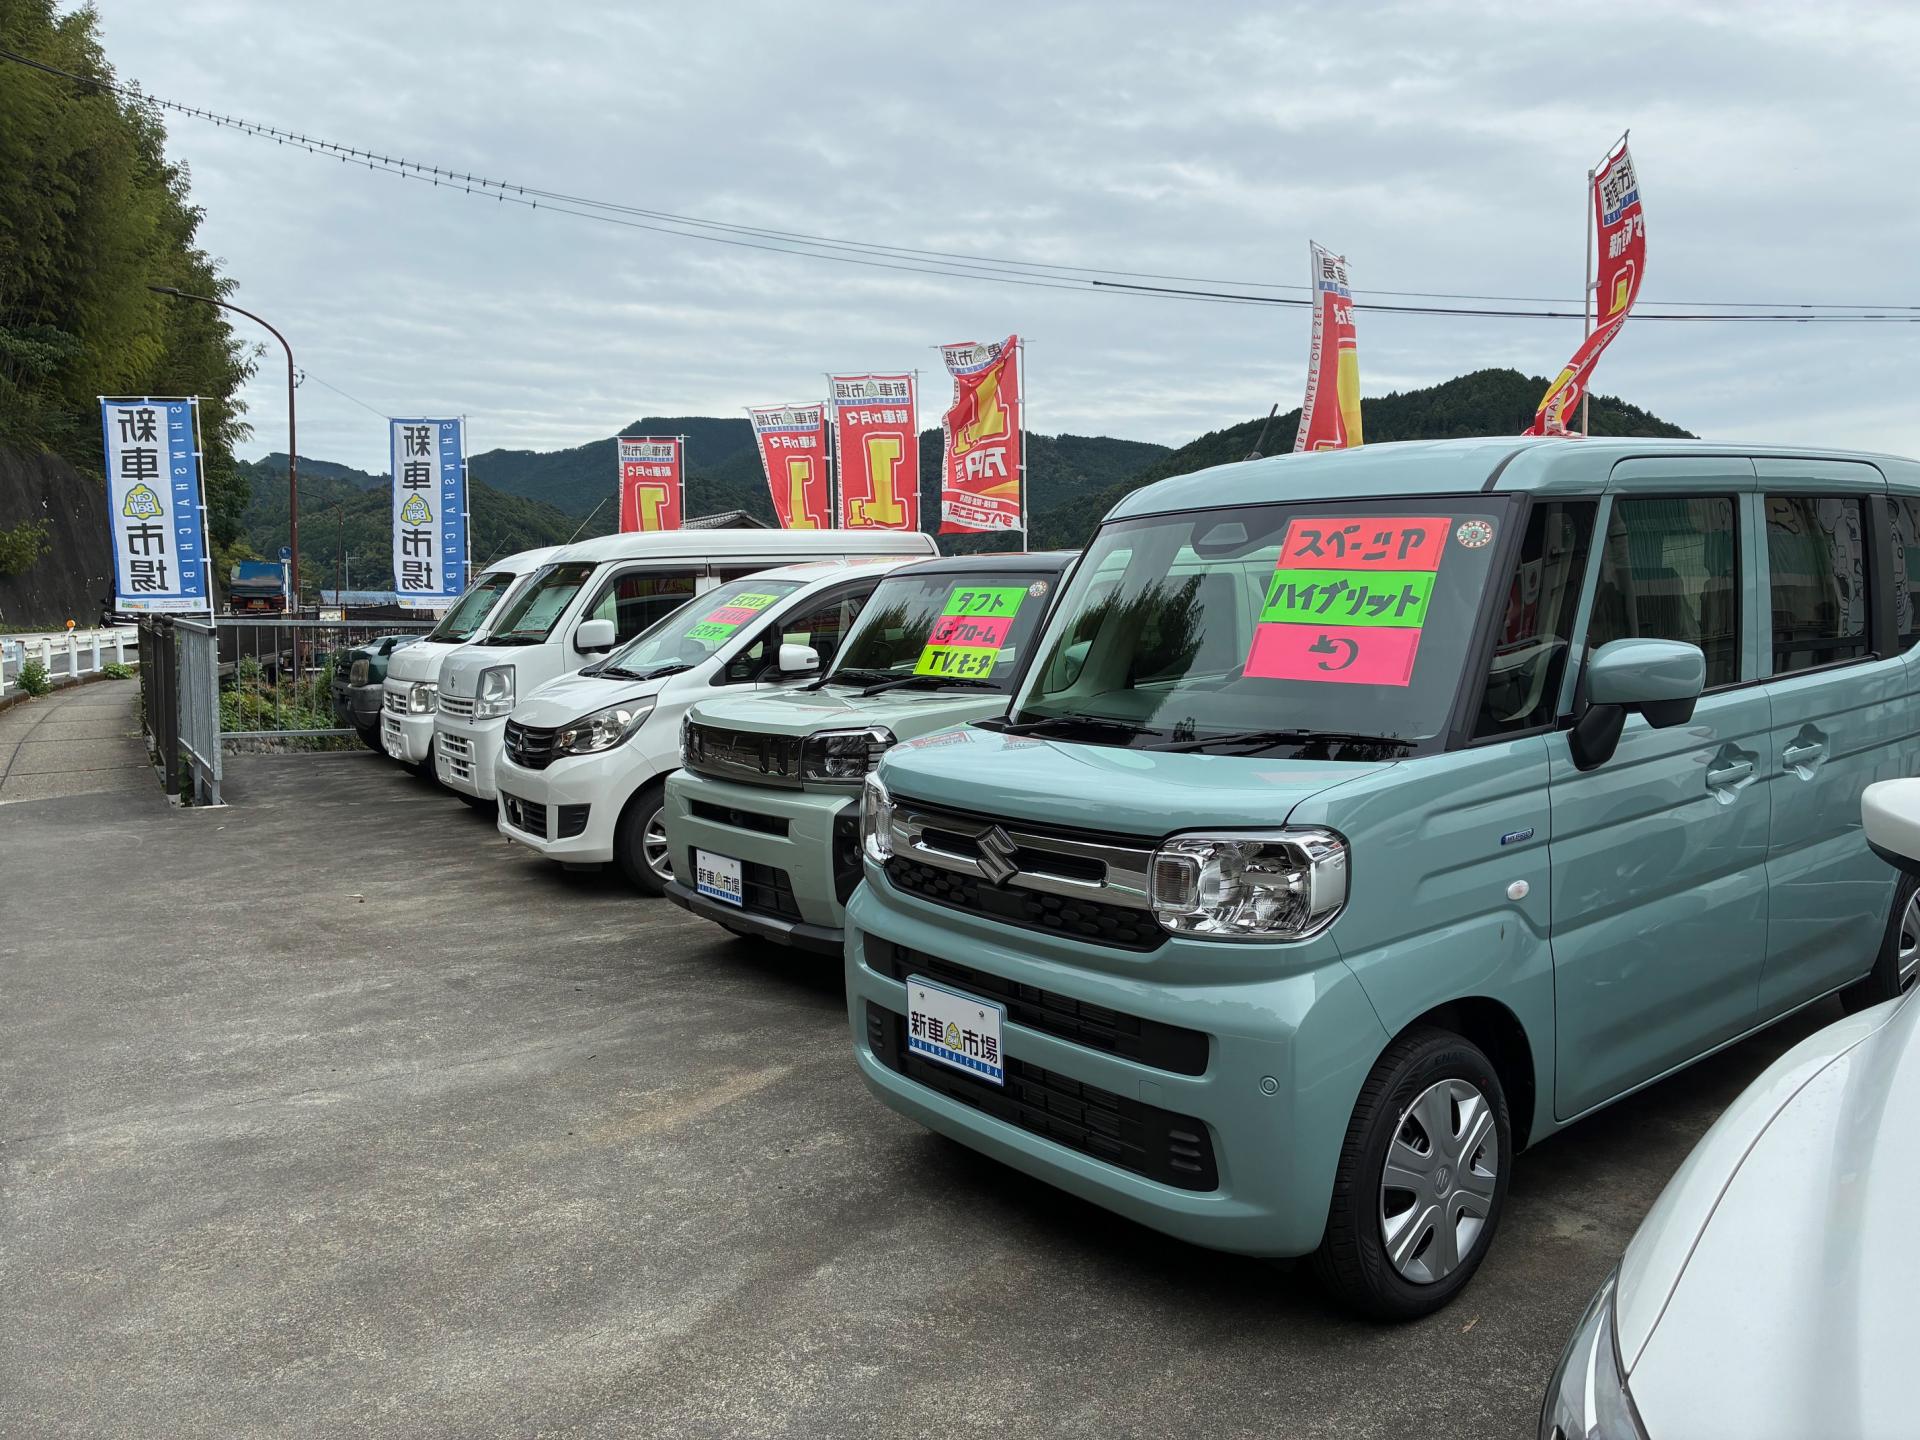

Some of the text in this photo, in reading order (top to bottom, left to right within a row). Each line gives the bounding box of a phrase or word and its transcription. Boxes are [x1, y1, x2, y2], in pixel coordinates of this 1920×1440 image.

[958, 592, 1005, 613] タフト
[1267, 579, 1422, 618] ハイブリット
[698, 867, 740, 894] 新車市場
[911, 1010, 998, 1064] 新車市場
[911, 1037, 999, 1077] SHINSHAICHIBA
